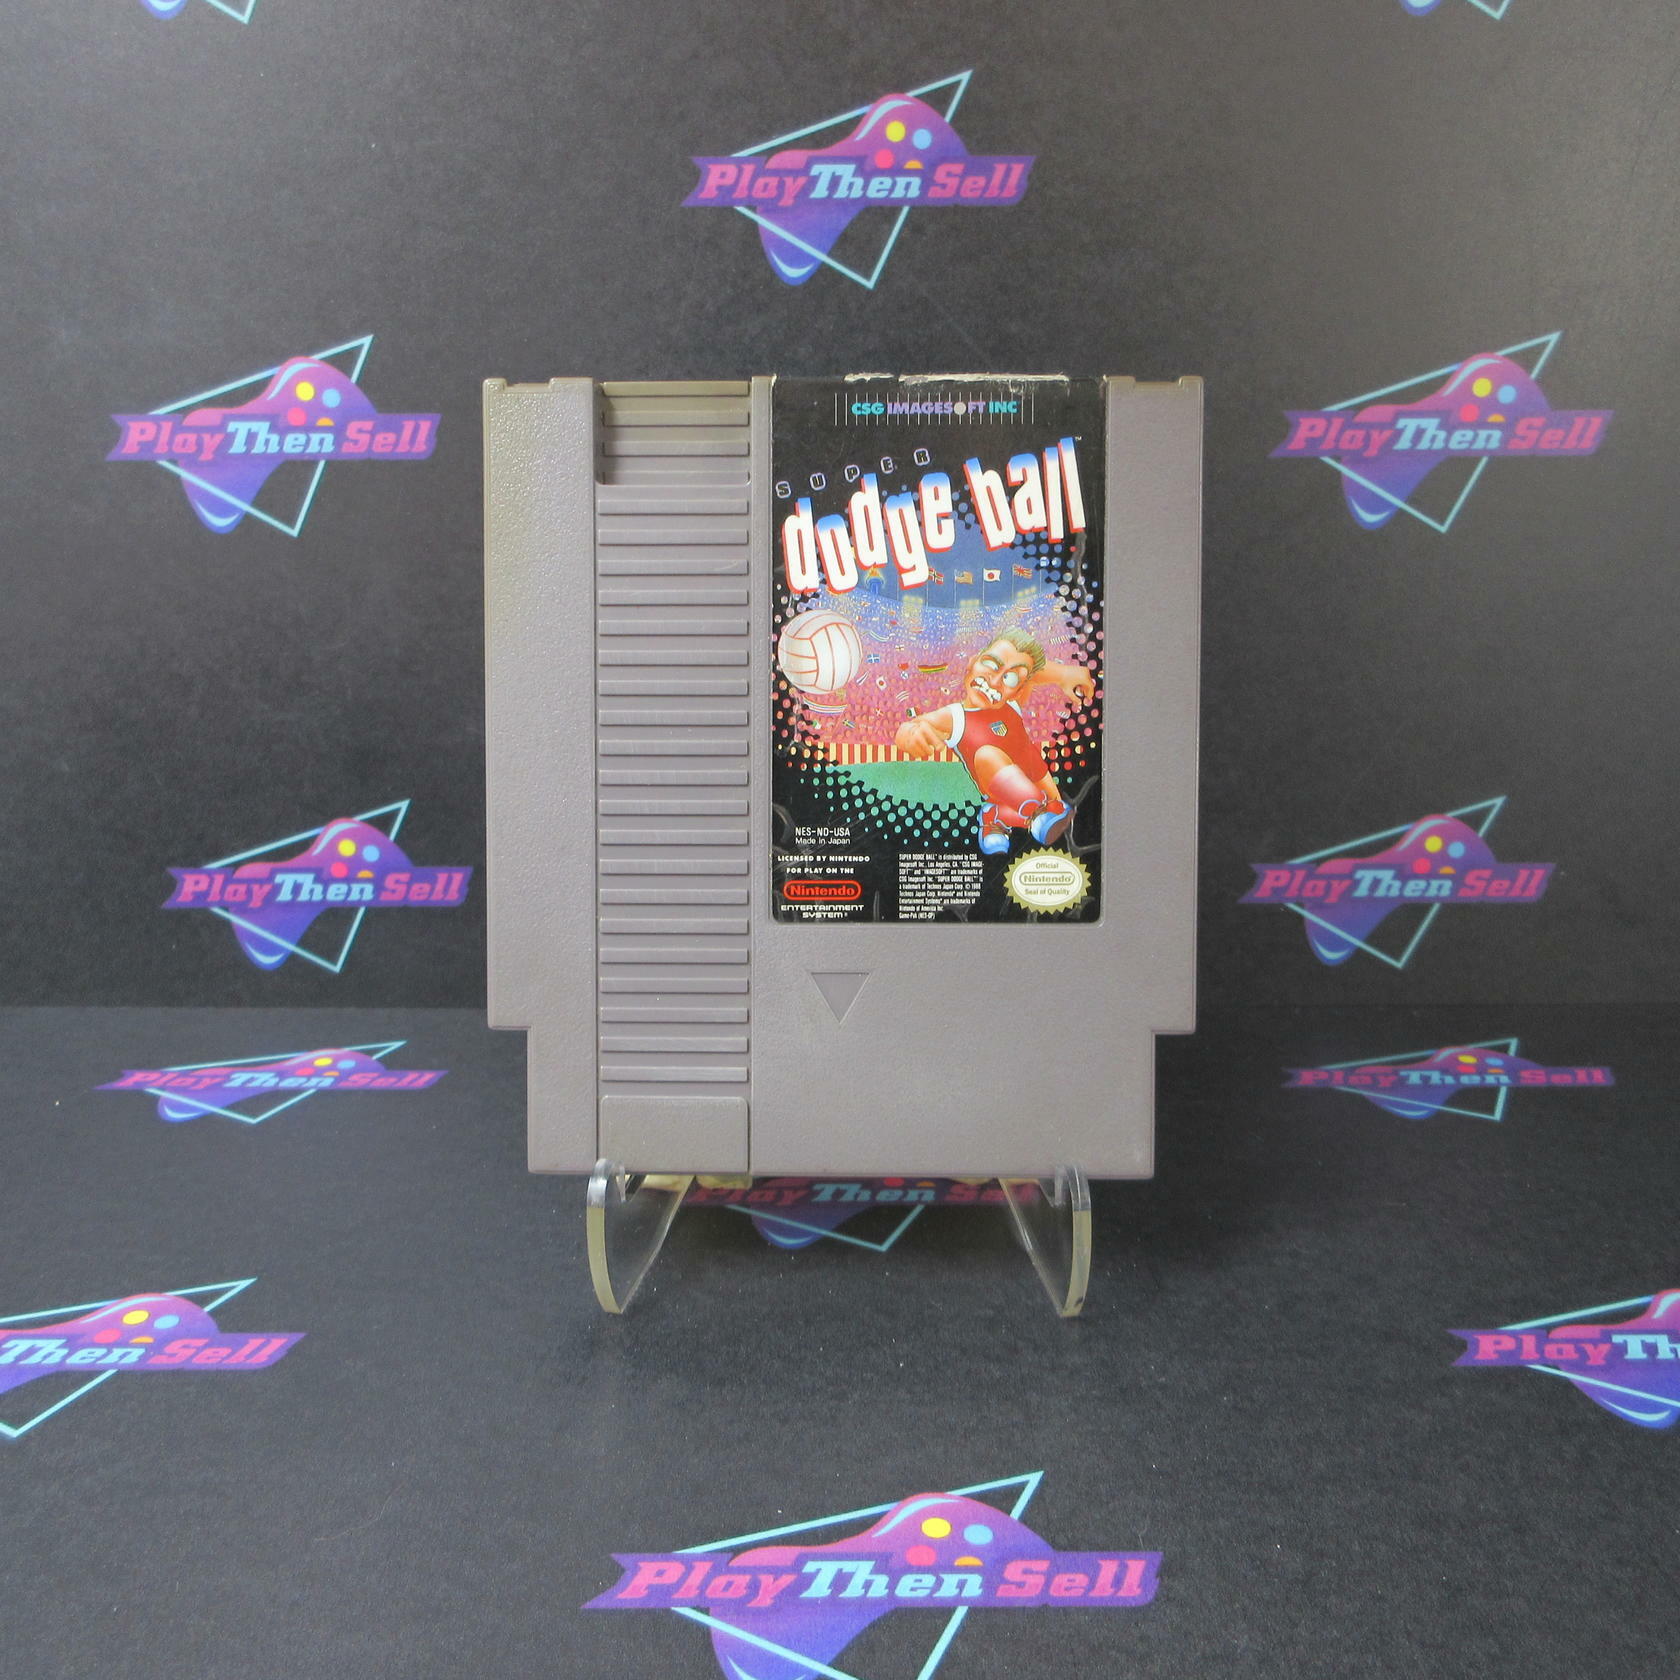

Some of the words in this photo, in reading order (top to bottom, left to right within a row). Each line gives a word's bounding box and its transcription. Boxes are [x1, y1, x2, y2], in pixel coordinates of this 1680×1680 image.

[700, 163, 809, 207] Play
[808, 163, 923, 200] Then
[927, 162, 1026, 199] Sell
[851, 402, 885, 415] CSG
[887, 401, 986, 415] IMAGESOFT
[988, 401, 1018, 414] INC
[121, 421, 225, 461] Play
[226, 421, 336, 455] Then
[341, 420, 433, 455] Sell
[1286, 417, 1396, 458] Play
[1392, 417, 1502, 451] Then
[1506, 417, 1602, 451] Sell
[775, 447, 931, 499] SUPER
[781, 472, 956, 595] dodge
[962, 436, 1087, 553] ball
[795, 827, 851, 837] NES-ND-USA
[795, 837, 816, 845] Made
[827, 837, 851, 846] Japan
[1035, 862, 1060, 870] Official
[1023, 875, 1071, 883] Nintendo
[1253, 869, 1353, 903] Play
[1351, 869, 1453, 898] Then
[1457, 869, 1547, 898] Sell
[175, 872, 274, 908] Play
[273, 872, 375, 902] Then
[379, 872, 465, 902] Sell
[790, 884, 856, 896] Nintendo
[1025, 888, 1039, 896] Seal
[1047, 888, 1070, 897] Quality
[781, 904, 865, 912] ENTERTAINMENT
[117, 1071, 223, 1091] Play
[223, 1071, 337, 1088] Then
[338, 1072, 437, 1088] Sell
[1298, 1069, 1399, 1088] Play
[1399, 1069, 1513, 1085] Then
[1518, 1068, 1607, 1085] Sell
[811, 1183, 937, 1202] Then
[0, 1338, 146, 1365] Then
[147, 1337, 290, 1365] Sell
[1473, 1334, 1613, 1366] Play
[611, 1560, 798, 1608] Play
[798, 1559, 985, 1599] Then
[993, 1559, 1148, 1600] Sell
